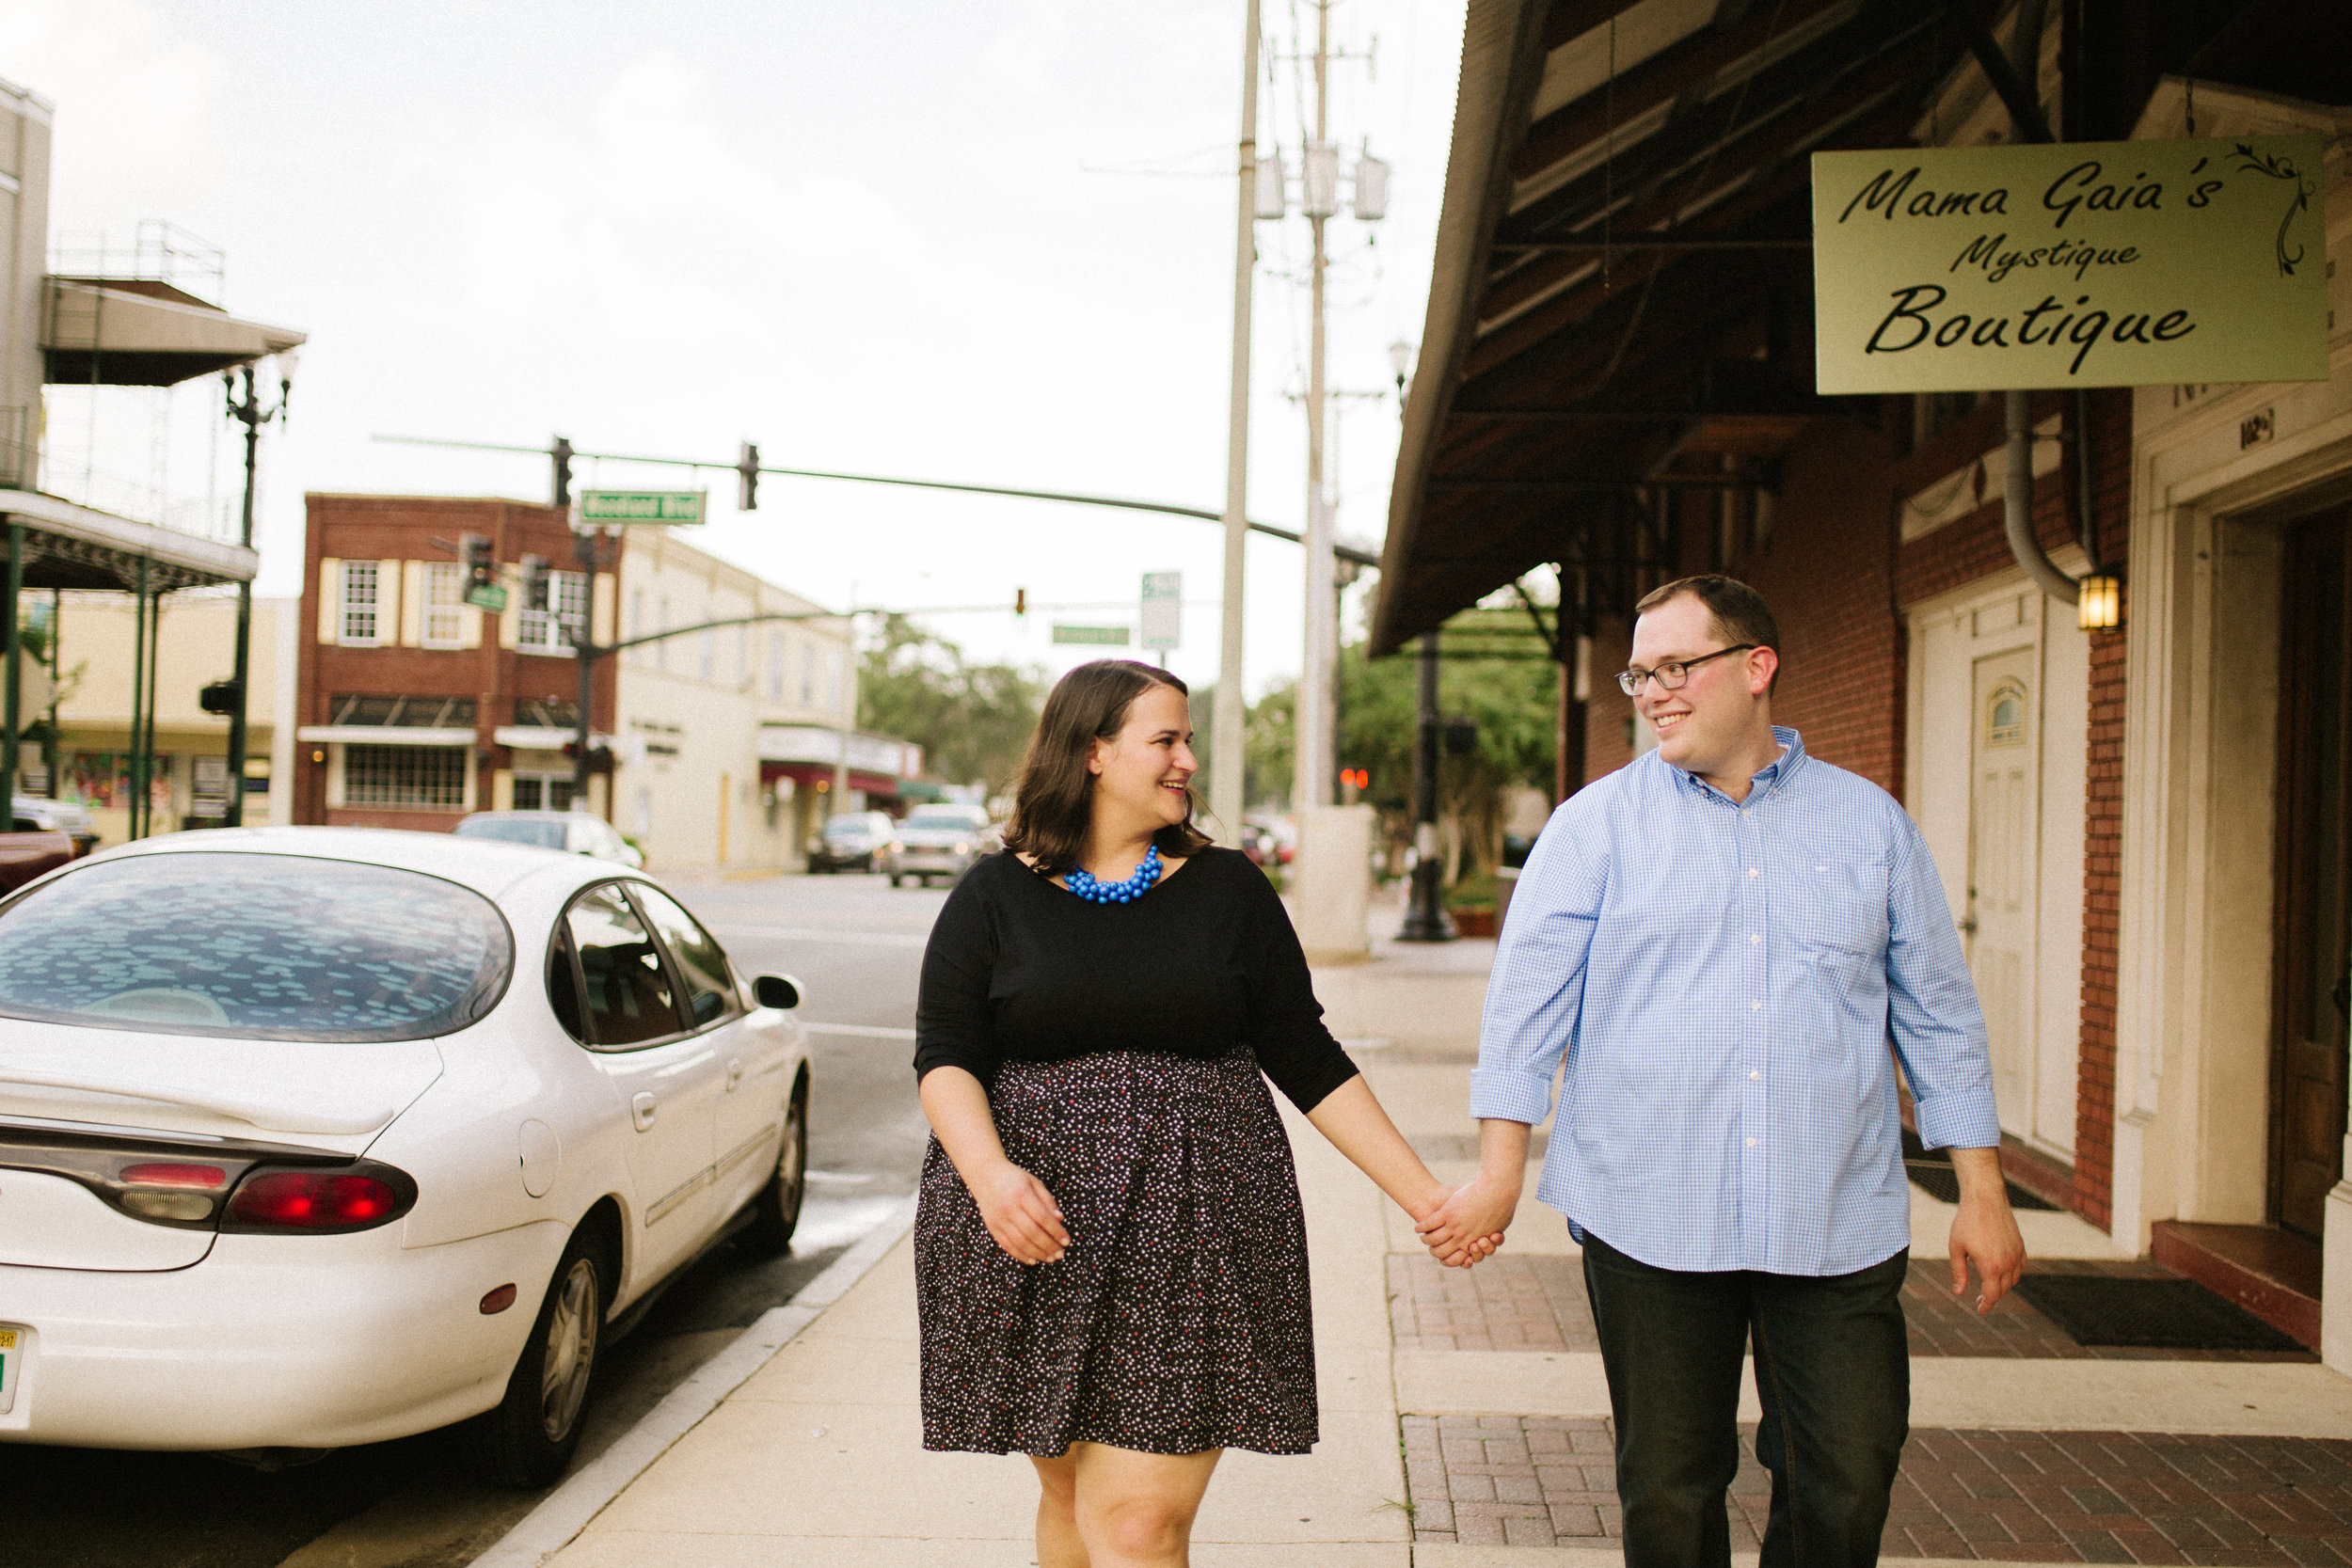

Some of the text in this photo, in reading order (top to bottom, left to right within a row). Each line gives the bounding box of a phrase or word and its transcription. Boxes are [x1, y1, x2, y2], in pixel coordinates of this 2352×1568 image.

[1838, 157, 2225, 229] Mama Gaia's
[1949, 233, 2141, 282] Mystique
[1865, 284, 2198, 375] Boutique
